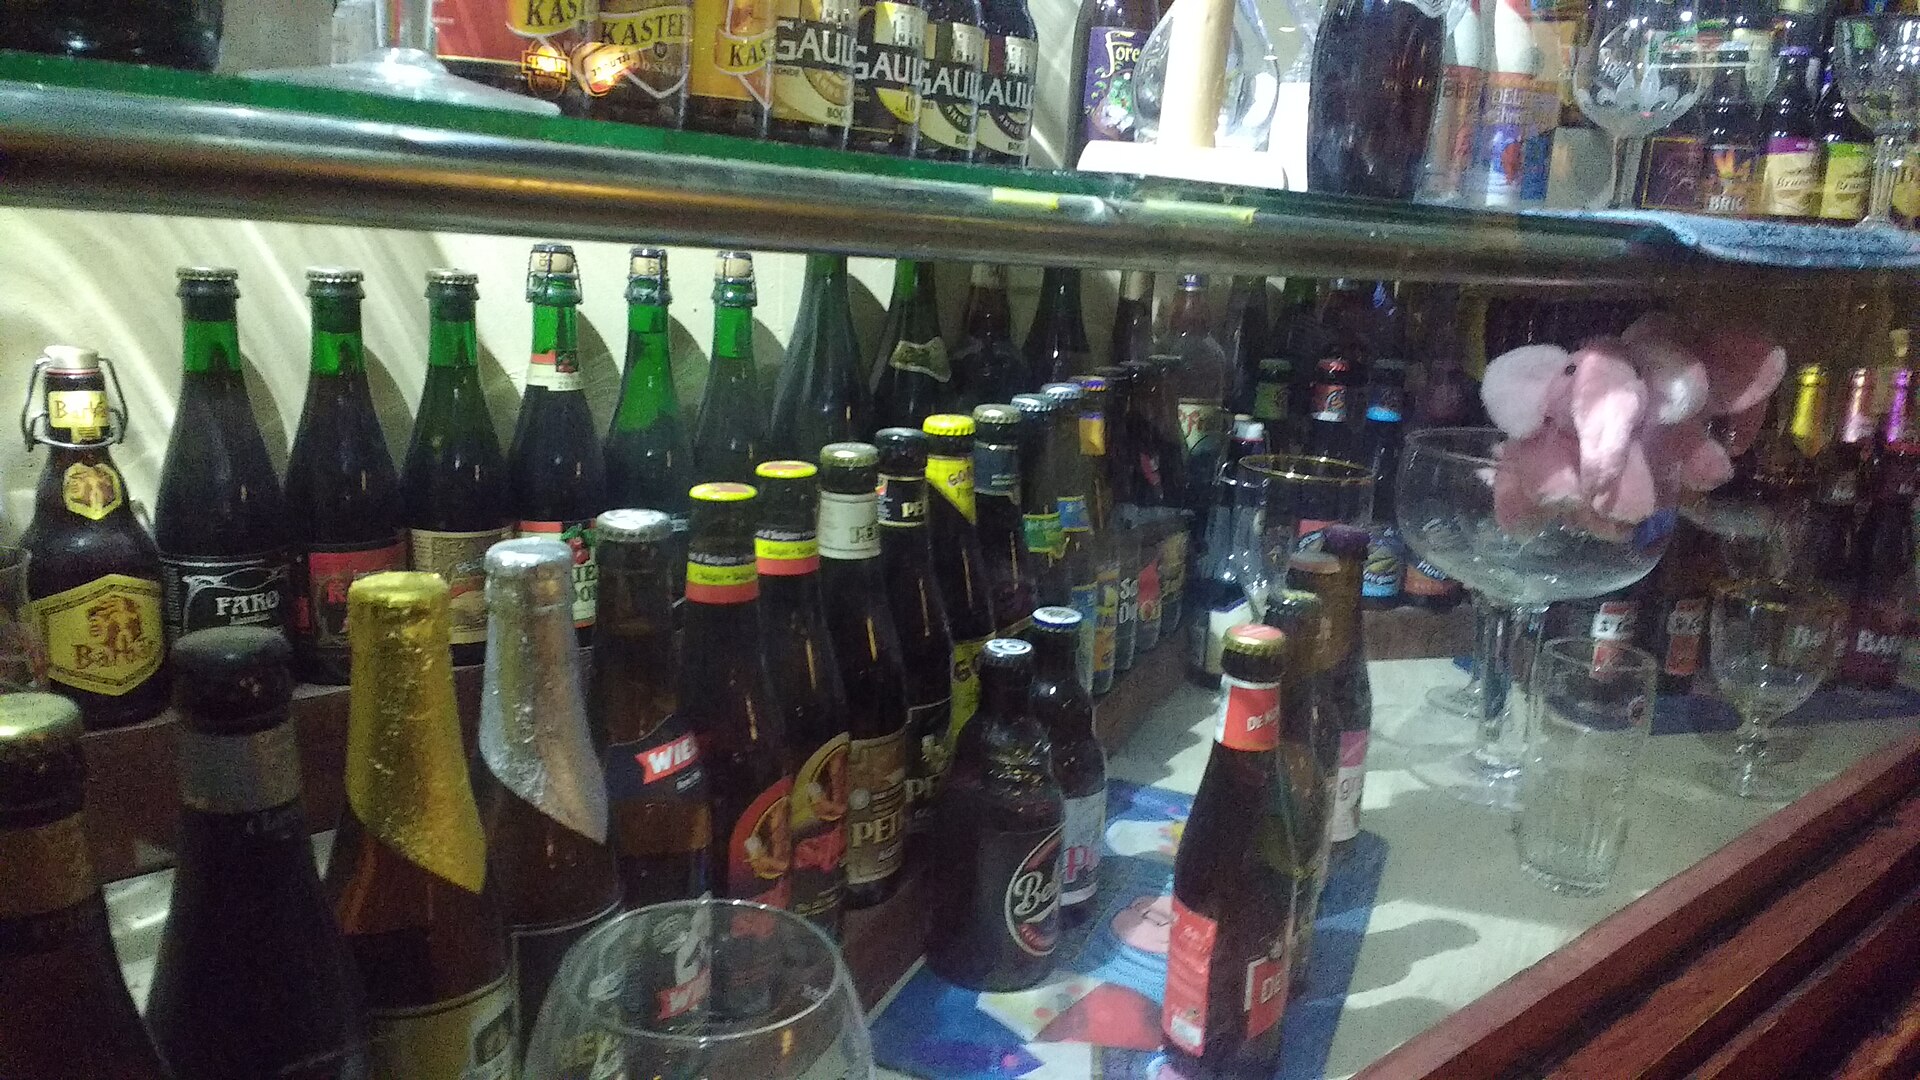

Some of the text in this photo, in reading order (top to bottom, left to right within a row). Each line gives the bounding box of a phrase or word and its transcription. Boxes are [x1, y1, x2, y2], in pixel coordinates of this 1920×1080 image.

[775, 19, 856, 69] GAUL
[1100, 30, 1141, 78] Fore
[214, 590, 281, 617] FARO
